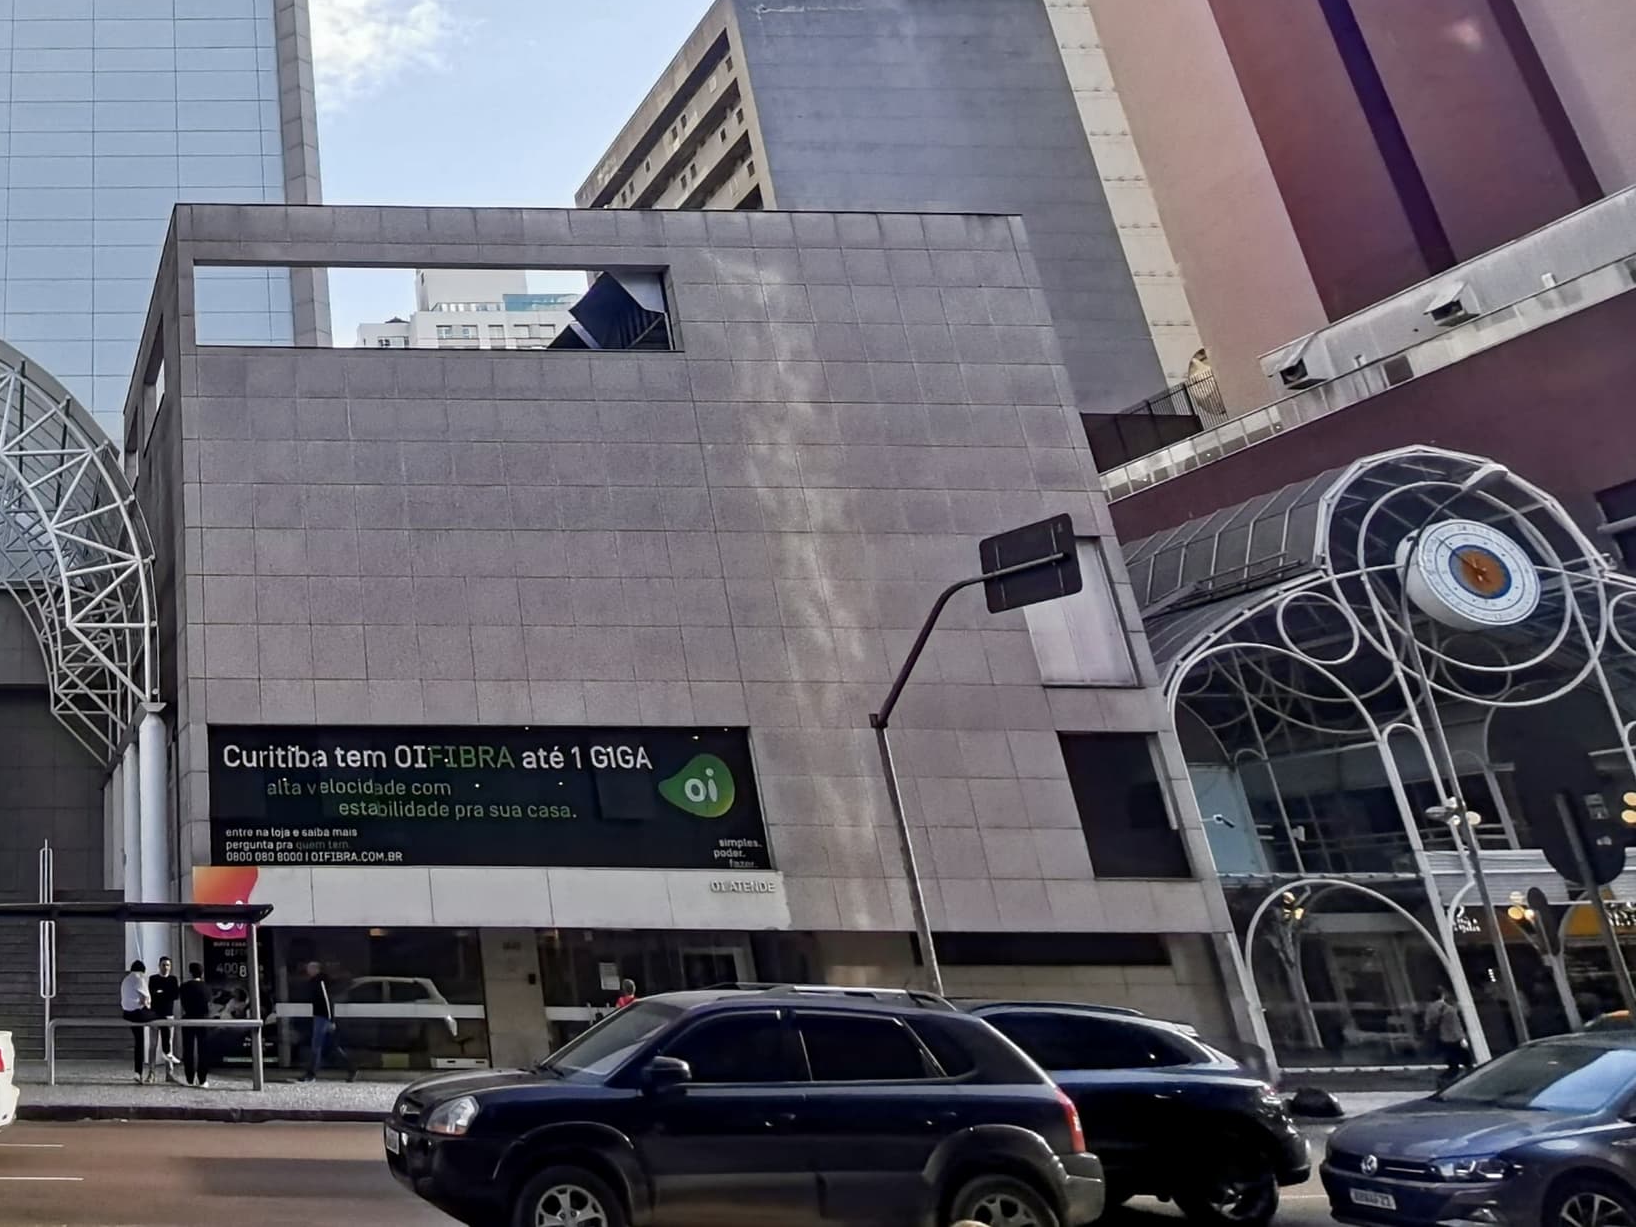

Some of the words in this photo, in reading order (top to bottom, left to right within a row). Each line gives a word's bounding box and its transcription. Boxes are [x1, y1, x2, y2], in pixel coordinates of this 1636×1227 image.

[222, 744, 328, 768] Curitiba
[334, 746, 387, 768] tem
[394, 745, 515, 768] OIFIBRA
[521, 745, 565, 769] até
[571, 746, 582, 769] 1
[267, 778, 302, 795] alta
[307, 778, 406, 795] velocidade
[411, 782, 451, 795] com
[683, 767, 718, 802] oi
[339, 800, 450, 818] estabilidade
[455, 804, 484, 821] pra
[489, 804, 522, 818] sua
[527, 804, 577, 818] casa.
[225, 828, 253, 837] entre
[255, 829, 269, 837] na
[271, 827, 290, 839] loja
[292, 829, 300, 837] e
[302, 827, 330, 837] saiba
[332, 827, 358, 837] mais
[226, 840, 274, 851] pergunta
[276, 841, 293, 851] pra
[295, 841, 326, 851] quem
[718, 838, 763, 849] simples.
[226, 851, 252, 862] 0800
[254, 851, 275, 862] 080
[277, 851, 303, 862] 8000
[310, 851, 403, 862] OIFIBRA.COM.BR
[729, 881, 776, 893] ATENDE
